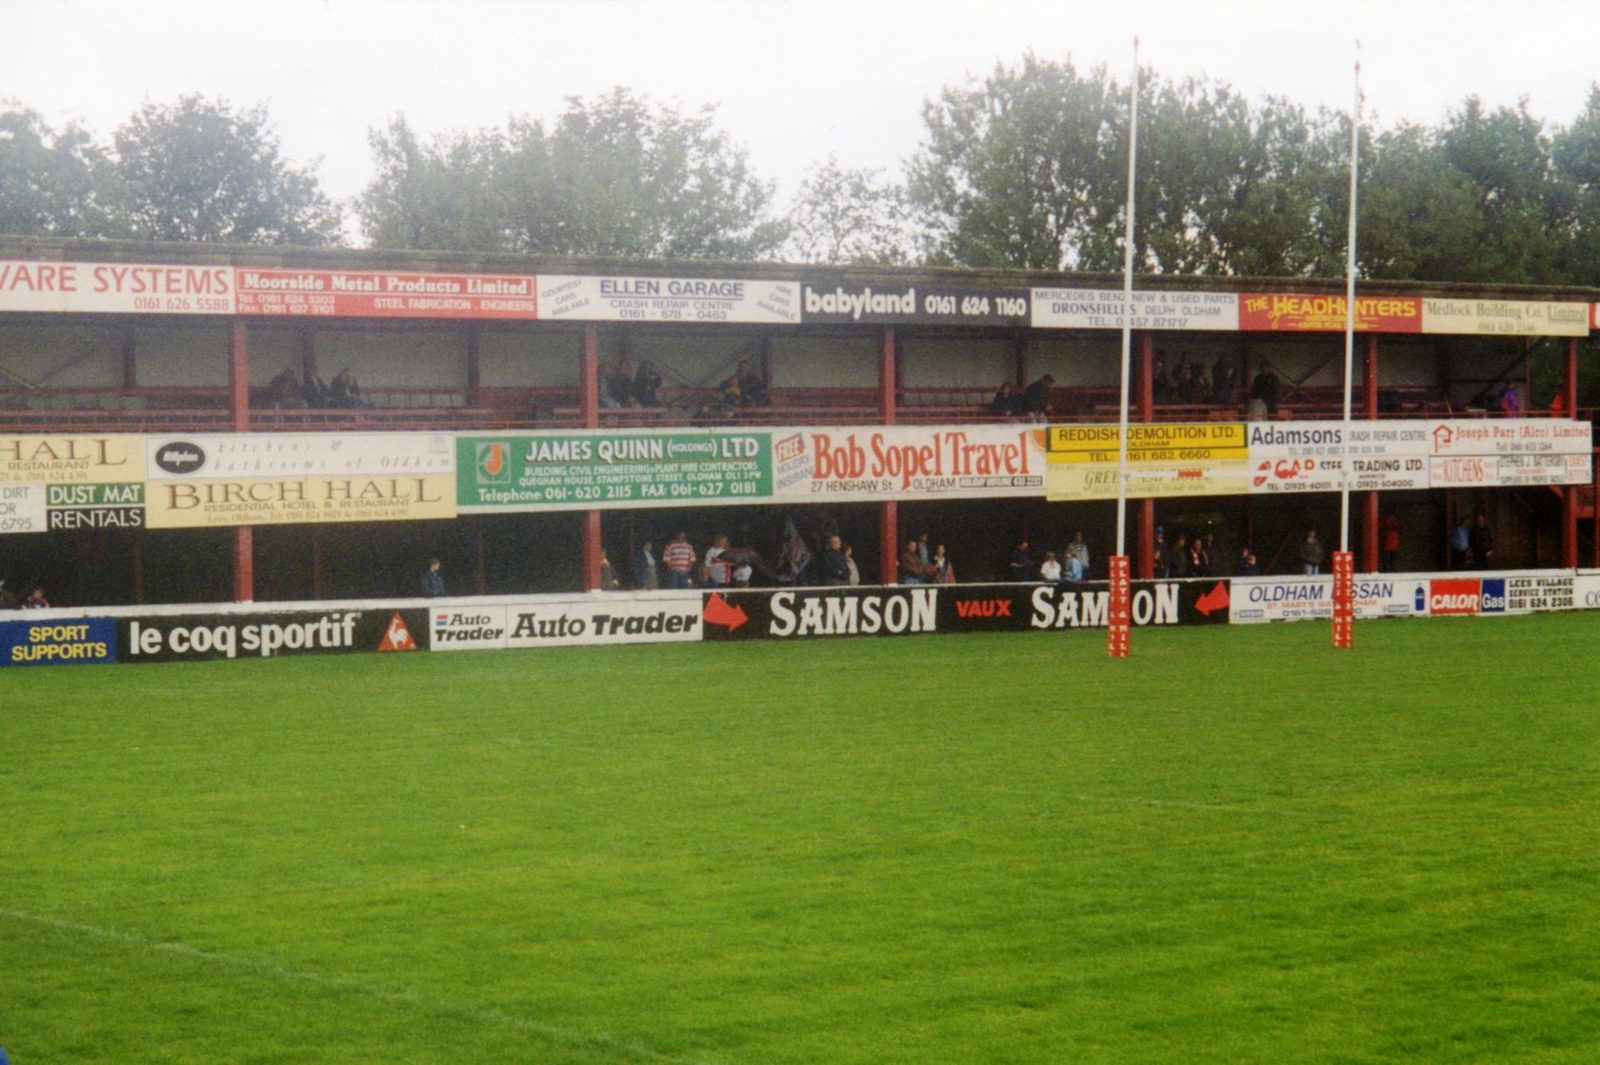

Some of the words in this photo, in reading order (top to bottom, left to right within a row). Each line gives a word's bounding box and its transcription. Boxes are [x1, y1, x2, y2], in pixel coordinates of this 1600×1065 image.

[0, 265, 77, 292] ARE
[93, 267, 229, 295] SYSTEMS
[244, 273, 324, 290] Moorside
[331, 275, 380, 292] Metal
[387, 277, 460, 293] Products
[467, 278, 527, 295] Limited
[600, 279, 660, 296] ELLEN
[667, 281, 744, 297] GARAGE
[134, 298, 160, 309] 0161
[166, 298, 191, 310] 626
[374, 298, 404, 309] STEEL
[408, 298, 471, 310] FABRICATION
[480, 300, 534, 311] ENGINEERS
[610, 300, 649, 309] CRASH
[652, 300, 690, 309] REPAIR
[693, 301, 735, 310] CENTRE
[805, 287, 915, 320] babyland
[925, 295, 956, 314] 0161
[961, 297, 990, 315] 624
[995, 298, 1026, 316] 1160
[1035, 291, 1095, 301] MERCEDES
[1172, 294, 1200, 303] USED
[1203, 295, 1235, 304] PARTS
[1245, 296, 1268, 312] THE
[619, 309, 645, 319] 0161
[1052, 303, 1137, 315] DRONSFIELS
[1145, 305, 1176, 315] DELPH
[1182, 306, 1221, 316] OLDHAM
[1426, 302, 1472, 316] Medlock
[1476, 303, 1522, 319] Building
[1547, 305, 1587, 320] Limited
[1059, 428, 1119, 441] REDDISH
[1126, 427, 1207, 440] DEMOLITION
[1212, 426, 1237, 438] LTD.
[1251, 425, 1342, 445] Adamsons
[1373, 430, 1398, 441] REPAIR
[1400, 430, 1426, 441] CENTRE
[1456, 426, 1489, 440] Joseph
[1493, 425, 1515, 438] Parr
[1553, 425, 1590, 438] Limited
[525, 440, 592, 462] JAMES
[597, 439, 663, 463] QUINN
[722, 437, 759, 457] LTD
[777, 439, 801, 461] FREE
[1123, 452, 1146, 461] 161
[1151, 451, 1175, 460] 682
[7, 461, 90, 470] RESTAURANT
[569, 465, 592, 475] CIVIL
[656, 463, 679, 472] PLANT
[700, 461, 757, 472] CONTRACTORS
[811, 433, 866, 479] Bob
[870, 433, 943, 491] Sopel
[945, 431, 1029, 476] Travel
[1320, 461, 1343, 470] STEE
[1353, 460, 1400, 471] TRADING
[686, 472, 722, 481] OLDHAM
[3, 486, 30, 499] DIRT
[811, 481, 823, 493] 27
[826, 480, 879, 492] HENSHAW
[913, 478, 956, 490] OLDHAM
[50, 485, 97, 504] DUST
[103, 484, 141, 502] MAT
[165, 482, 305, 510] BIRCH
[325, 478, 442, 503] HALL
[204, 502, 276, 513] RESIDENTIAL
[282, 500, 316, 510] HOTEL
[340, 499, 409, 509] RESTAURANT
[51, 509, 141, 529] RENTALS
[1509, 579, 1532, 587] LEES
[1536, 577, 1574, 586] VILLAGE
[1250, 584, 1323, 602] OLDHAM
[1331, 583, 1393, 599] SSAN
[1509, 588, 1539, 597] SERVICE
[1543, 588, 1573, 596] STATION
[1031, 583, 1179, 628] SAMON
[1318, 600, 1331, 608] WA
[1431, 594, 1478, 610] CALOR
[1482, 593, 1504, 608] Gas
[1530, 597, 1547, 607] 624
[769, 588, 938, 636] SAMSON
[956, 599, 1012, 618] VAUX
[449, 614, 491, 626] Auto
[510, 612, 586, 638] Auto
[591, 611, 699, 636] Trader
[28, 625, 90, 642] SPORT
[130, 621, 162, 655] le
[168, 625, 236, 658] coq
[241, 612, 356, 657] sportif
[435, 627, 503, 641] Trader
[11, 642, 107, 661] SUPPORTS
